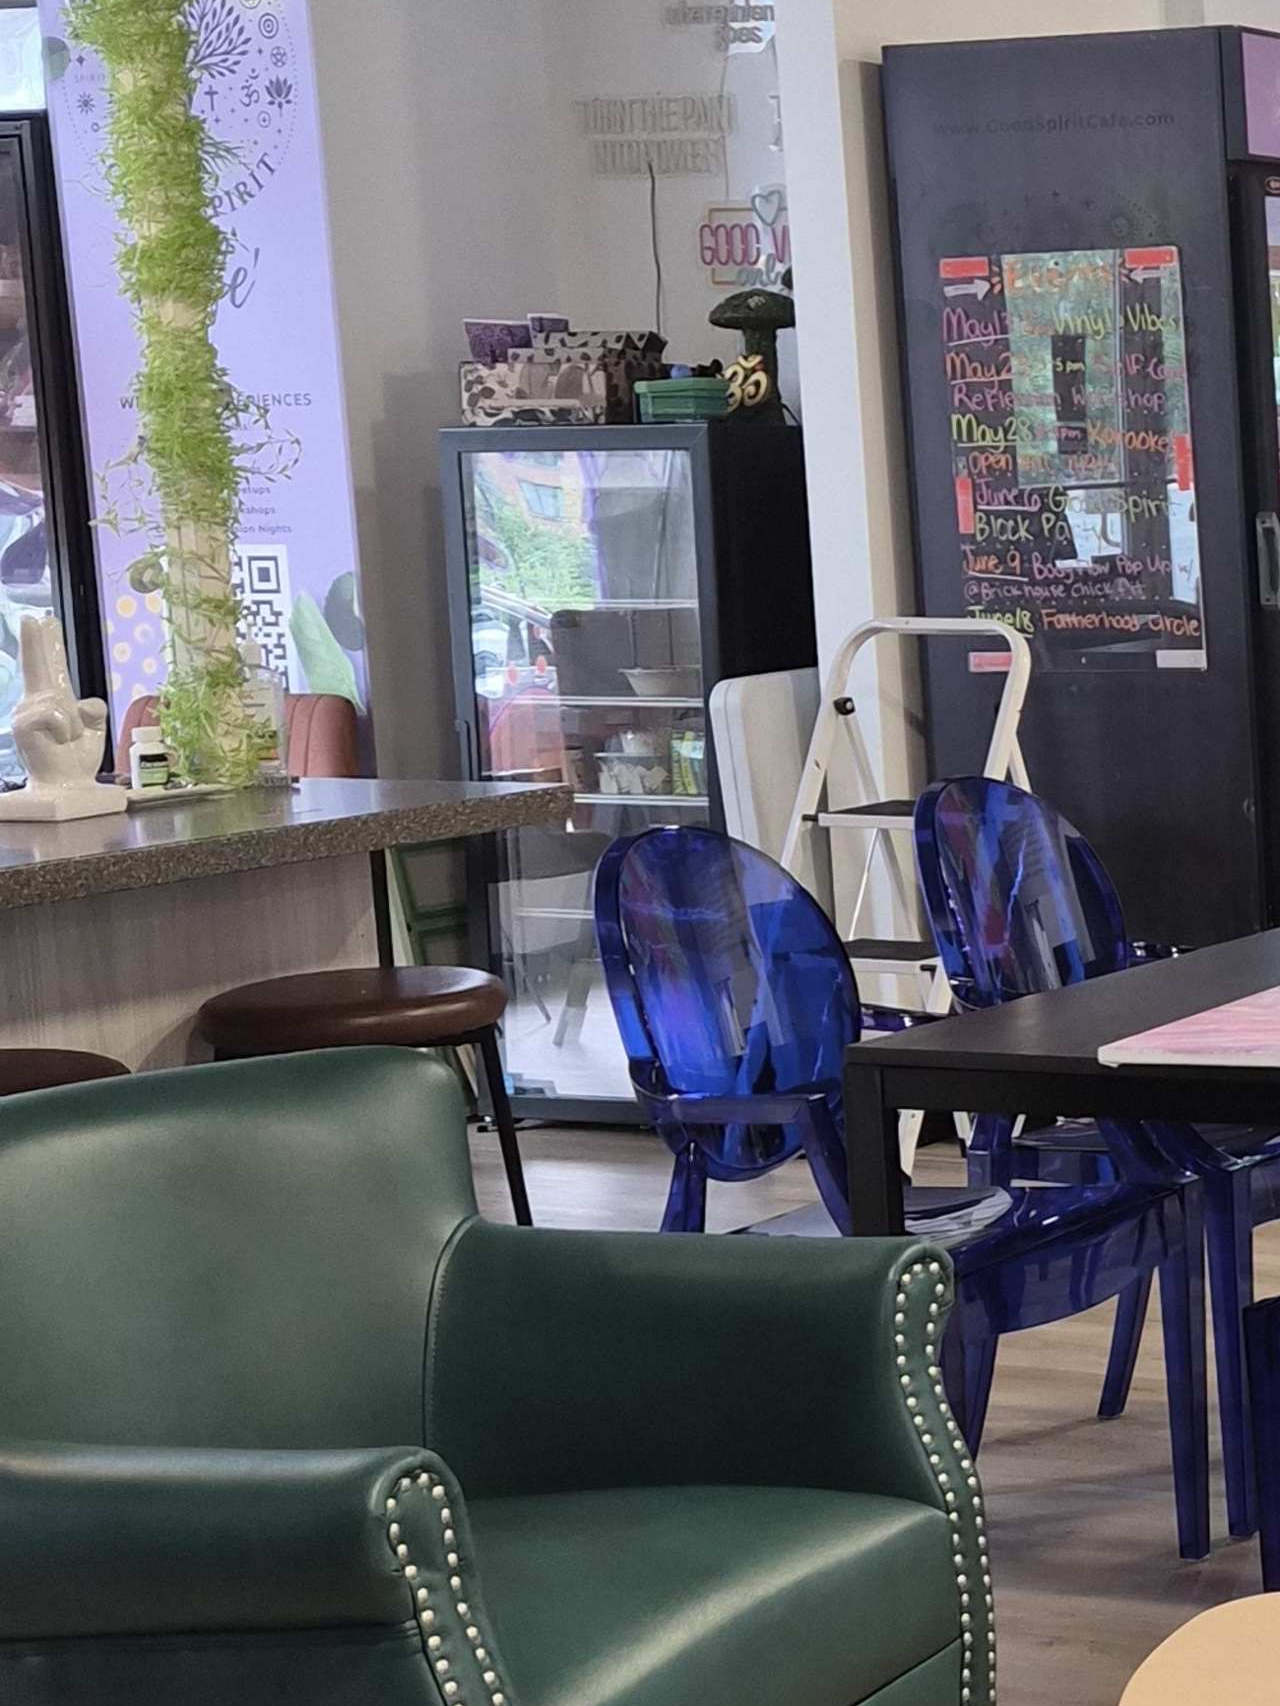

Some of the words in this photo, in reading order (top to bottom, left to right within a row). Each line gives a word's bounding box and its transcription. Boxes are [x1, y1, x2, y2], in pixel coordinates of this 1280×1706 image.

[205, 151, 276, 219] PIRIT
[700, 223, 761, 266] GOOD
[975, 512, 1034, 542] Block
